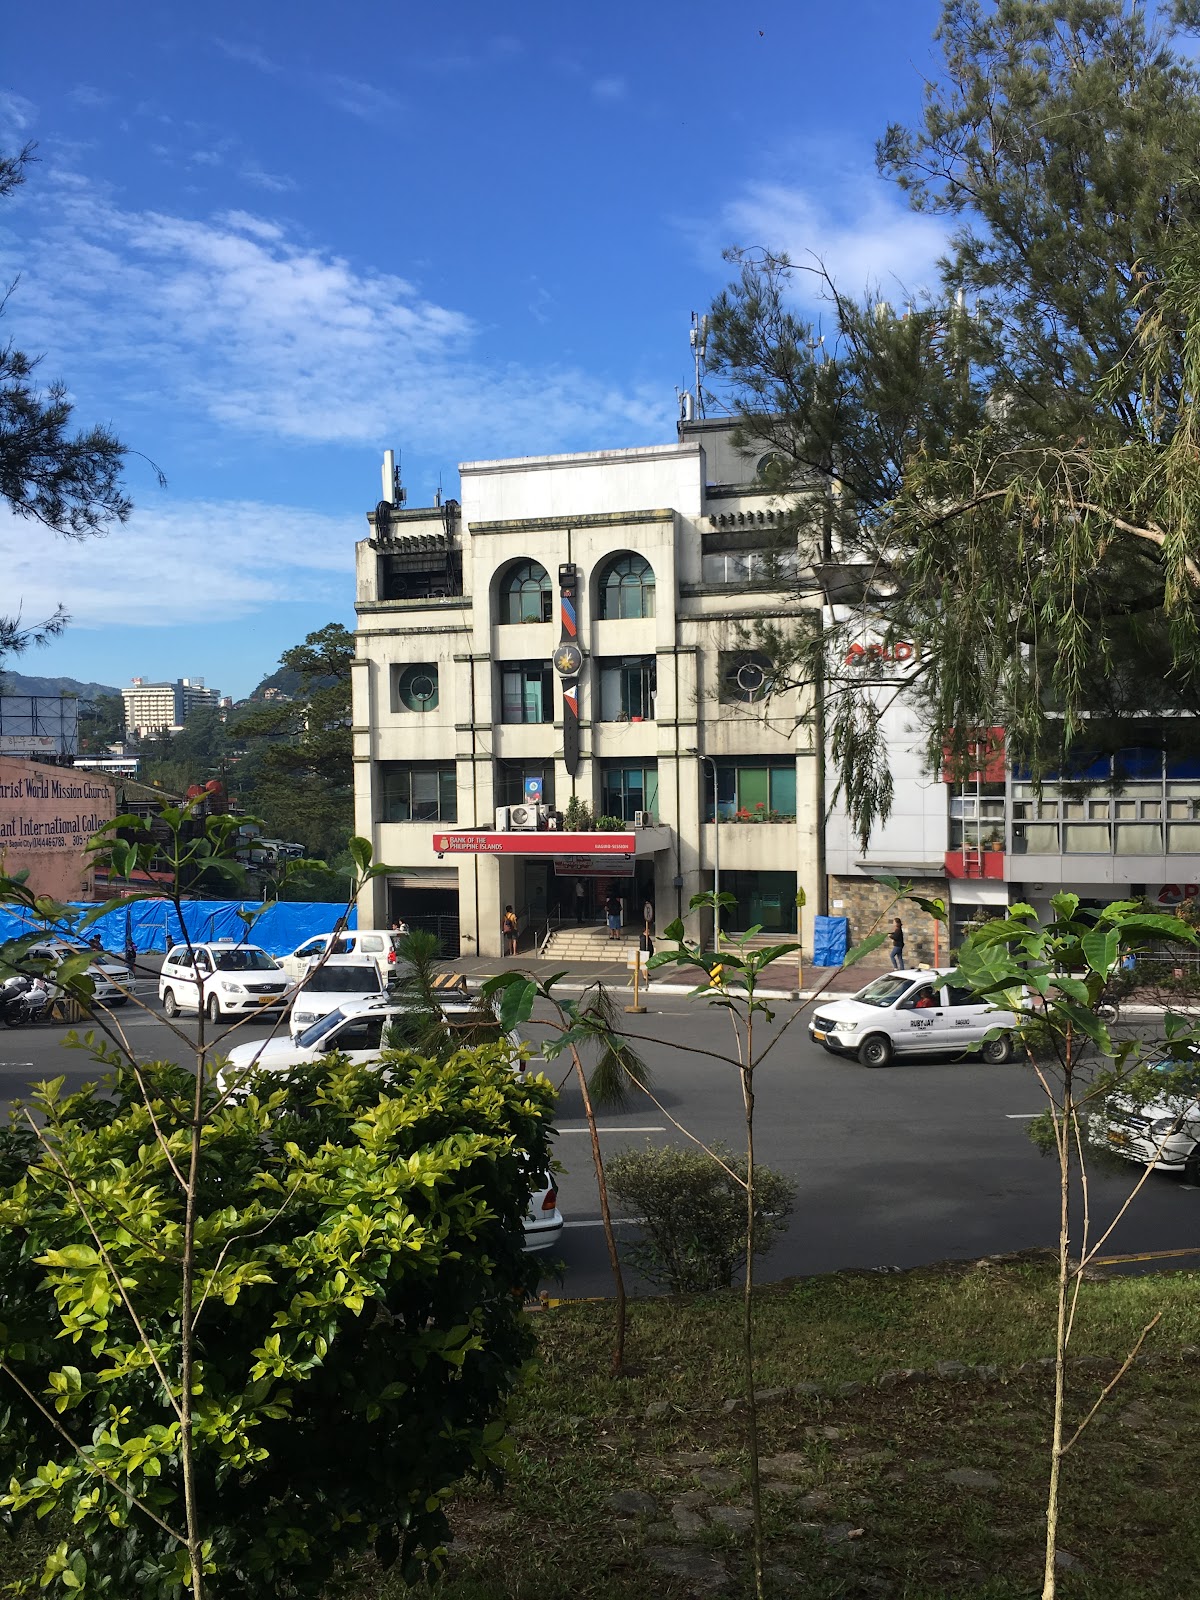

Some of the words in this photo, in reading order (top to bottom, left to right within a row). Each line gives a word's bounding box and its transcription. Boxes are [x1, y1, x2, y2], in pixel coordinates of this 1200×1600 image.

[0, 777, 23, 799] hrist
[24, 778, 49, 799] World
[51, 779, 82, 799] Mission
[0, 816, 16, 837] ant
[19, 815, 80, 837] International
